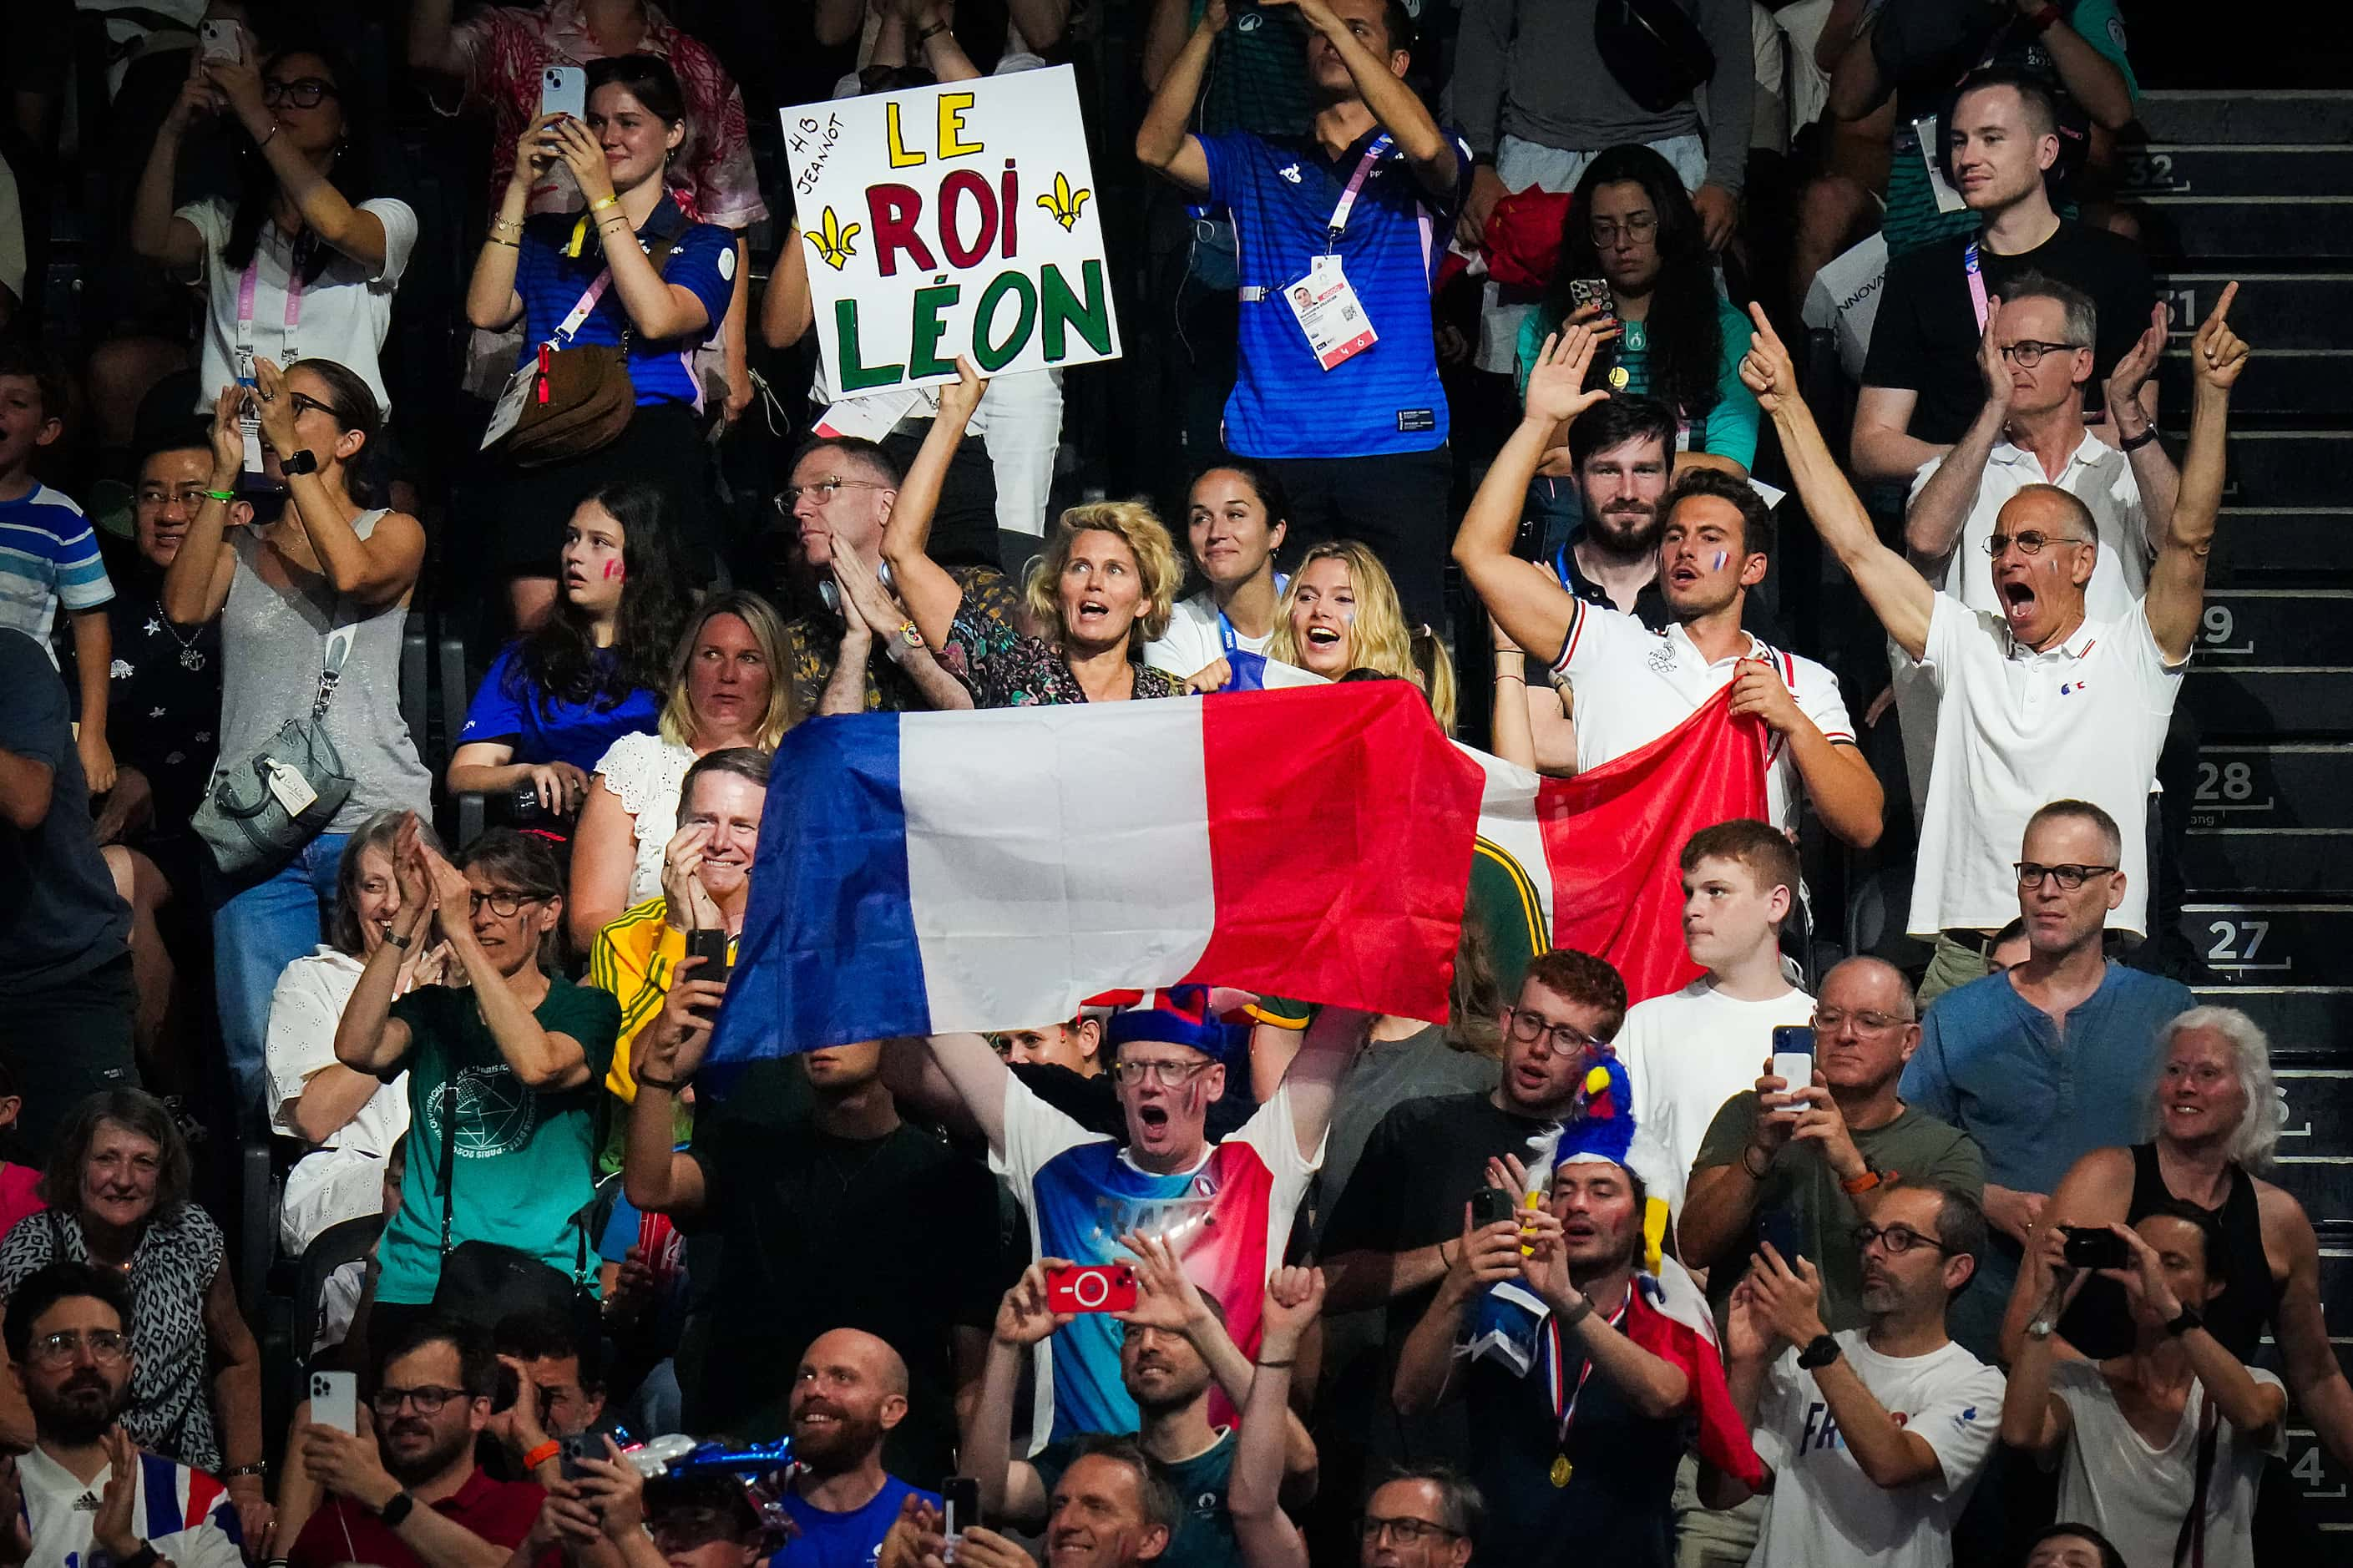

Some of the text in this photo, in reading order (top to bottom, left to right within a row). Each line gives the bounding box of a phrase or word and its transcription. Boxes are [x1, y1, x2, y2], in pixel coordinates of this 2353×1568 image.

[887, 93, 984, 169] LE
[797, 112, 847, 195] JEANNOT
[835, 259, 1112, 392] LÉON
[2199, 605, 2234, 644] 9
[2194, 761, 2253, 800] 28
[2209, 920, 2270, 959] 27
[2290, 1446, 2325, 1487] 4
